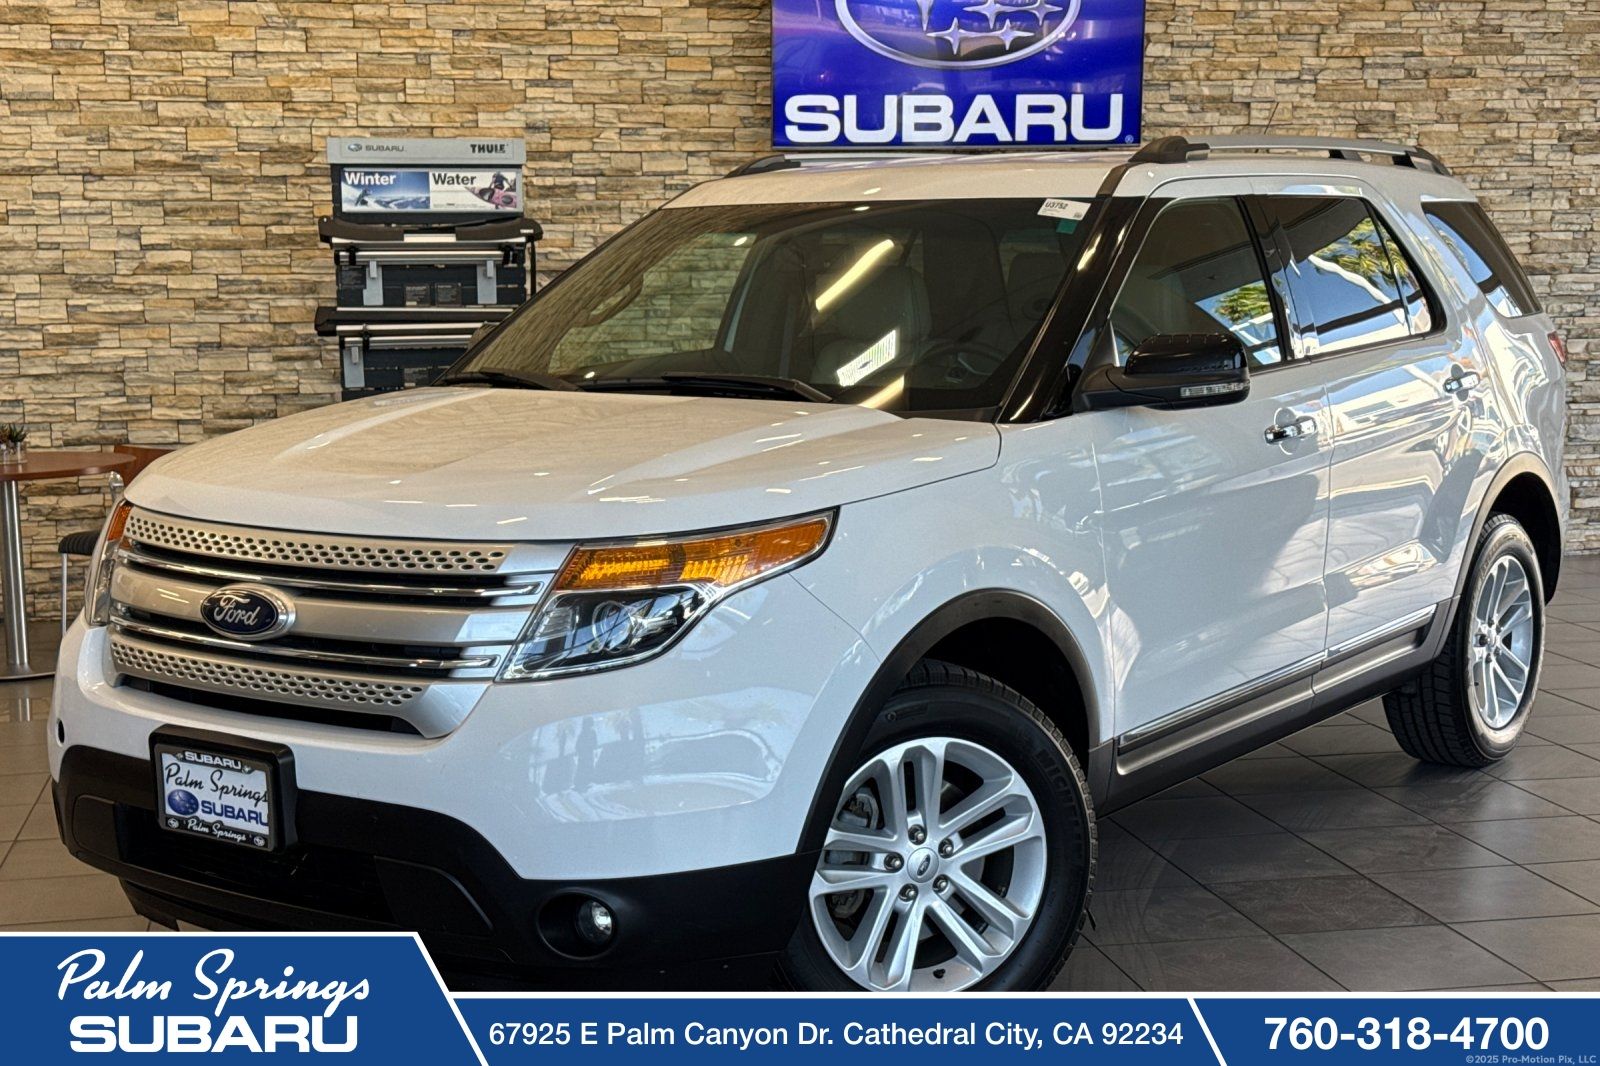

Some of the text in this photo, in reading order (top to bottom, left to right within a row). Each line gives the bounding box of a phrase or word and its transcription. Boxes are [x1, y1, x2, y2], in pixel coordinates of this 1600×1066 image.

[784, 93, 1123, 143] SUBARU
[470, 144, 506, 153] THULE
[344, 172, 396, 185] Winter
[432, 173, 477, 185] Water
[213, 594, 261, 626] Ford
[185, 752, 241, 769] SUBARU
[165, 762, 268, 808] Palm Springs
[187, 818, 247, 842] Palm Springs
